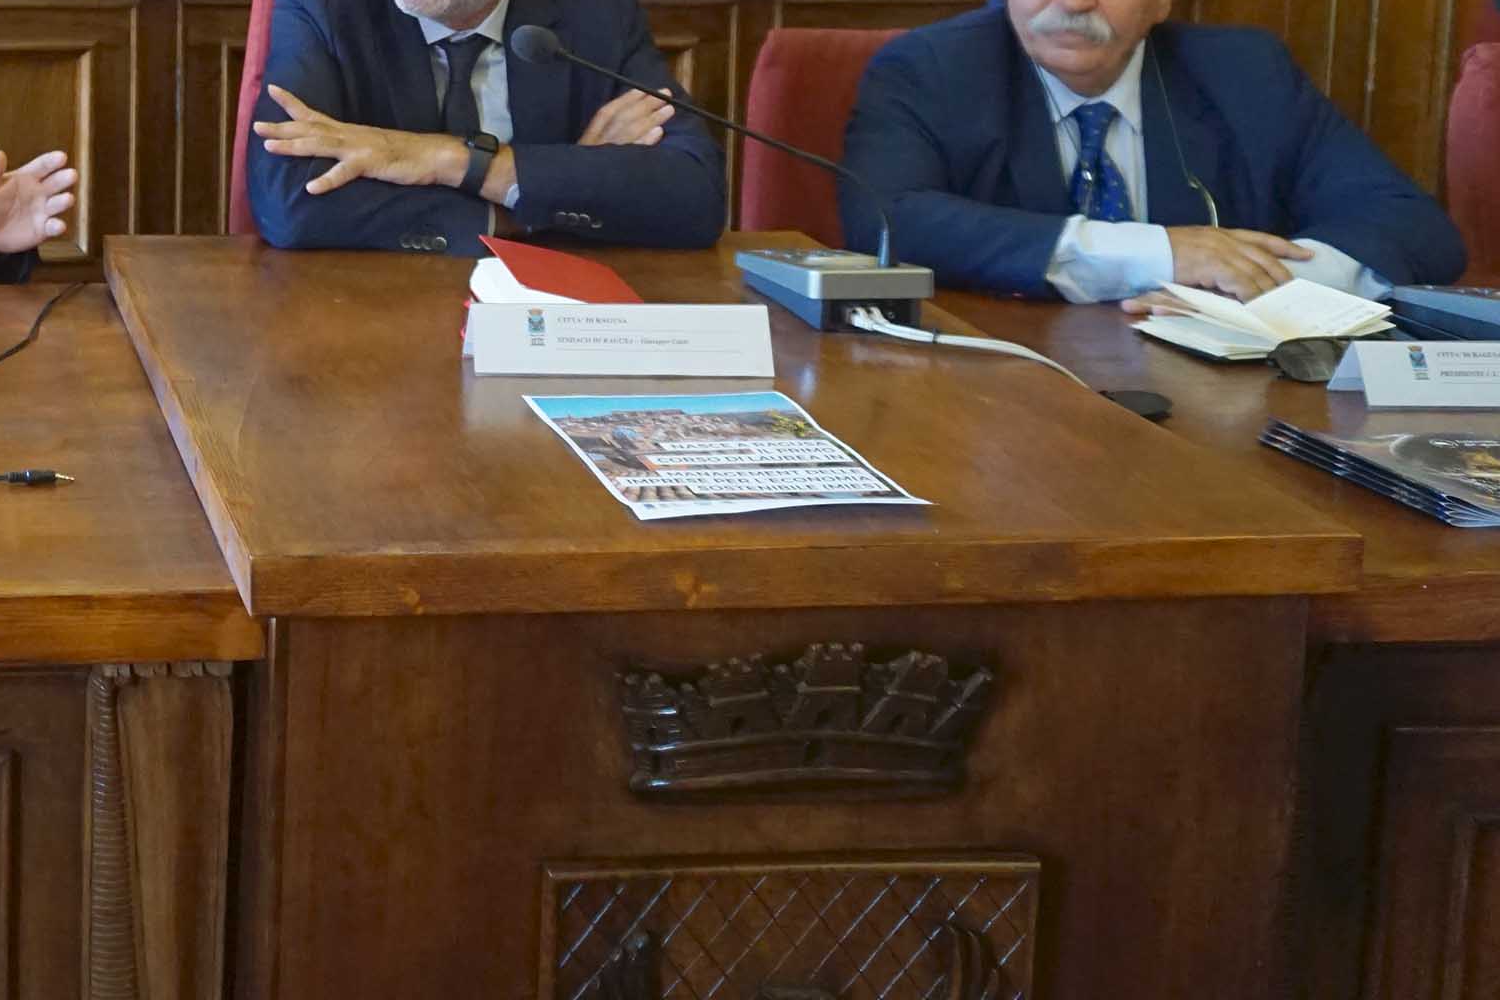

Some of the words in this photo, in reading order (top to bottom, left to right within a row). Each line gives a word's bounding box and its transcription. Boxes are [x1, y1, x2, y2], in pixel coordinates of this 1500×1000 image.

[671, 441, 730, 450] NASCE
[754, 440, 829, 448] RAGUSA
[657, 456, 721, 464] CORSO
[725, 455, 745, 463] DI
[748, 454, 822, 463] LAUREA
[826, 453, 846, 461] IN
[666, 469, 799, 478] MANAGEMENT
[626, 476, 711, 486] IMPRESE
[695, 483, 820, 493] SOSTENIBILE
